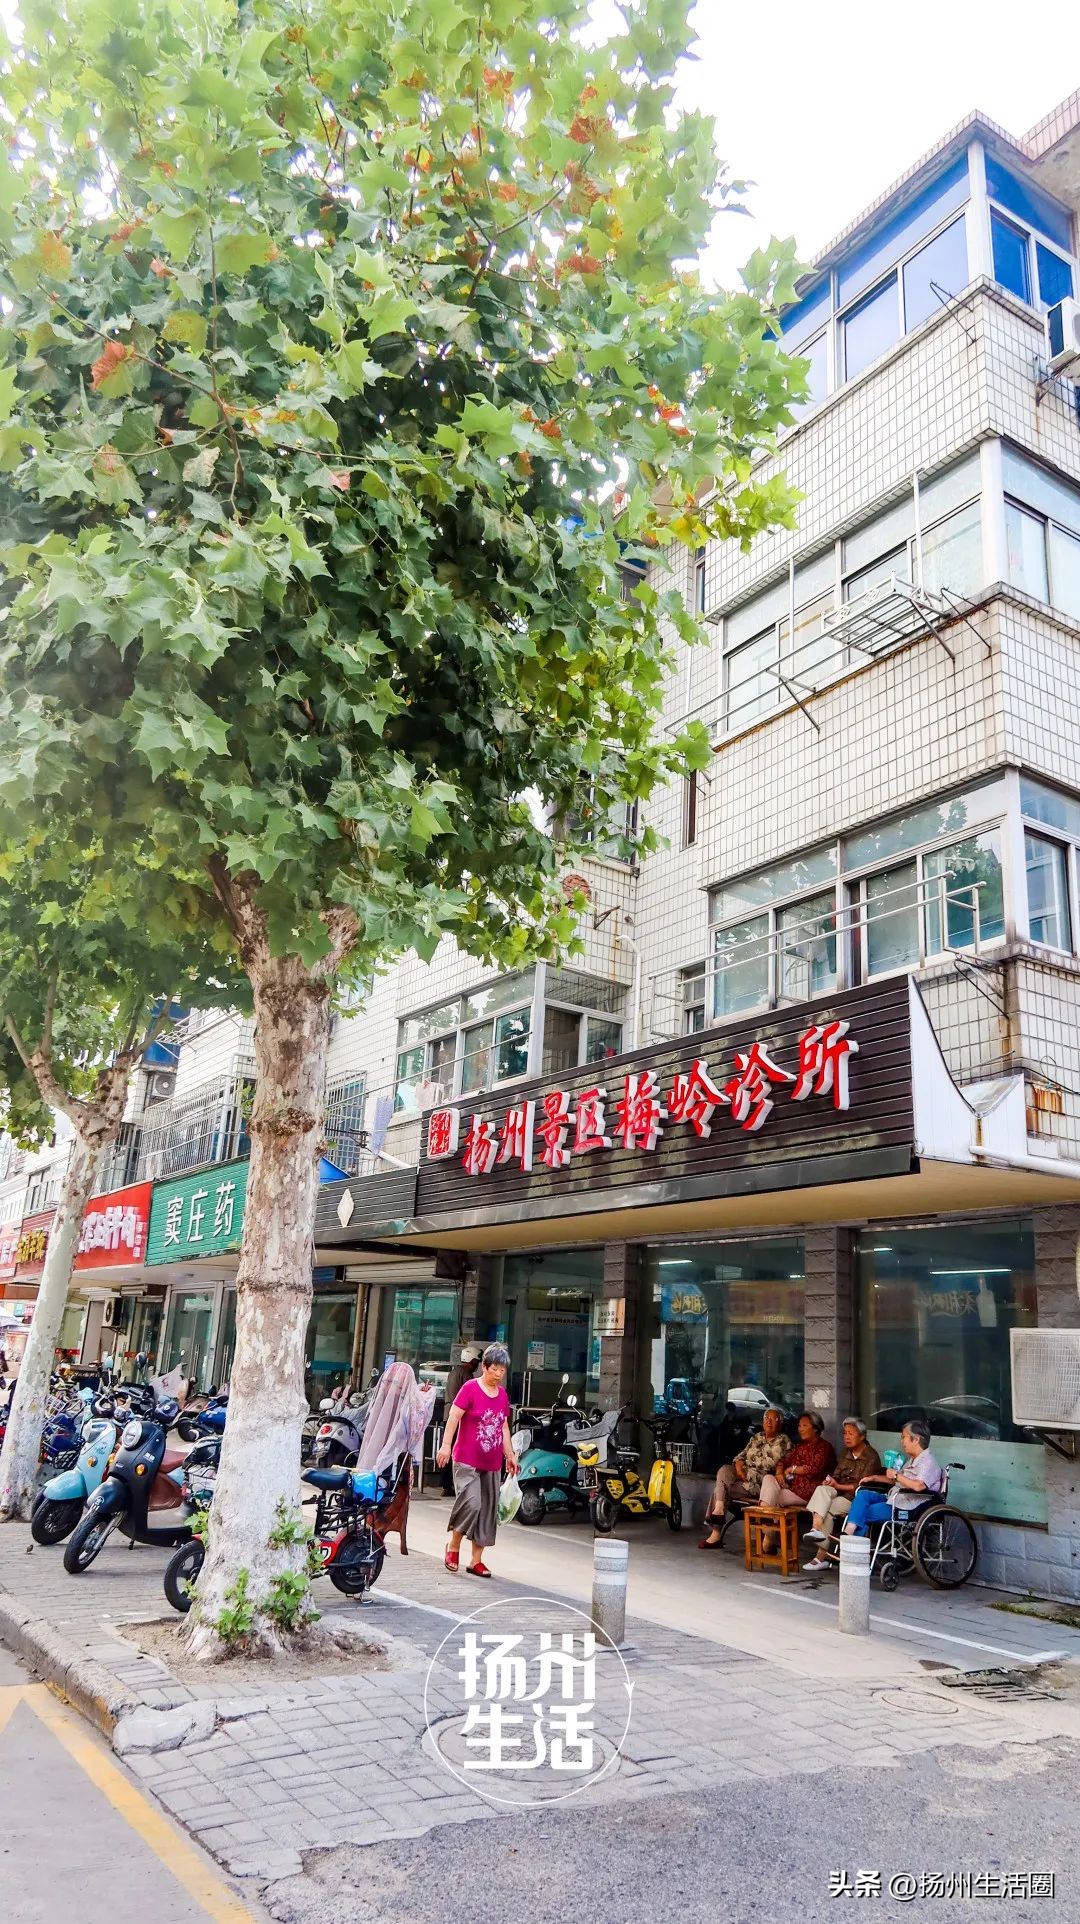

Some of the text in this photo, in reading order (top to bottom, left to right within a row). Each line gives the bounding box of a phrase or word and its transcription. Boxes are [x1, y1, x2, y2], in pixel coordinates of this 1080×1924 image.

[461, 1020, 859, 1176] 扬州景区梅岭诊所
[163, 1181, 245, 1247] 窦庄药
